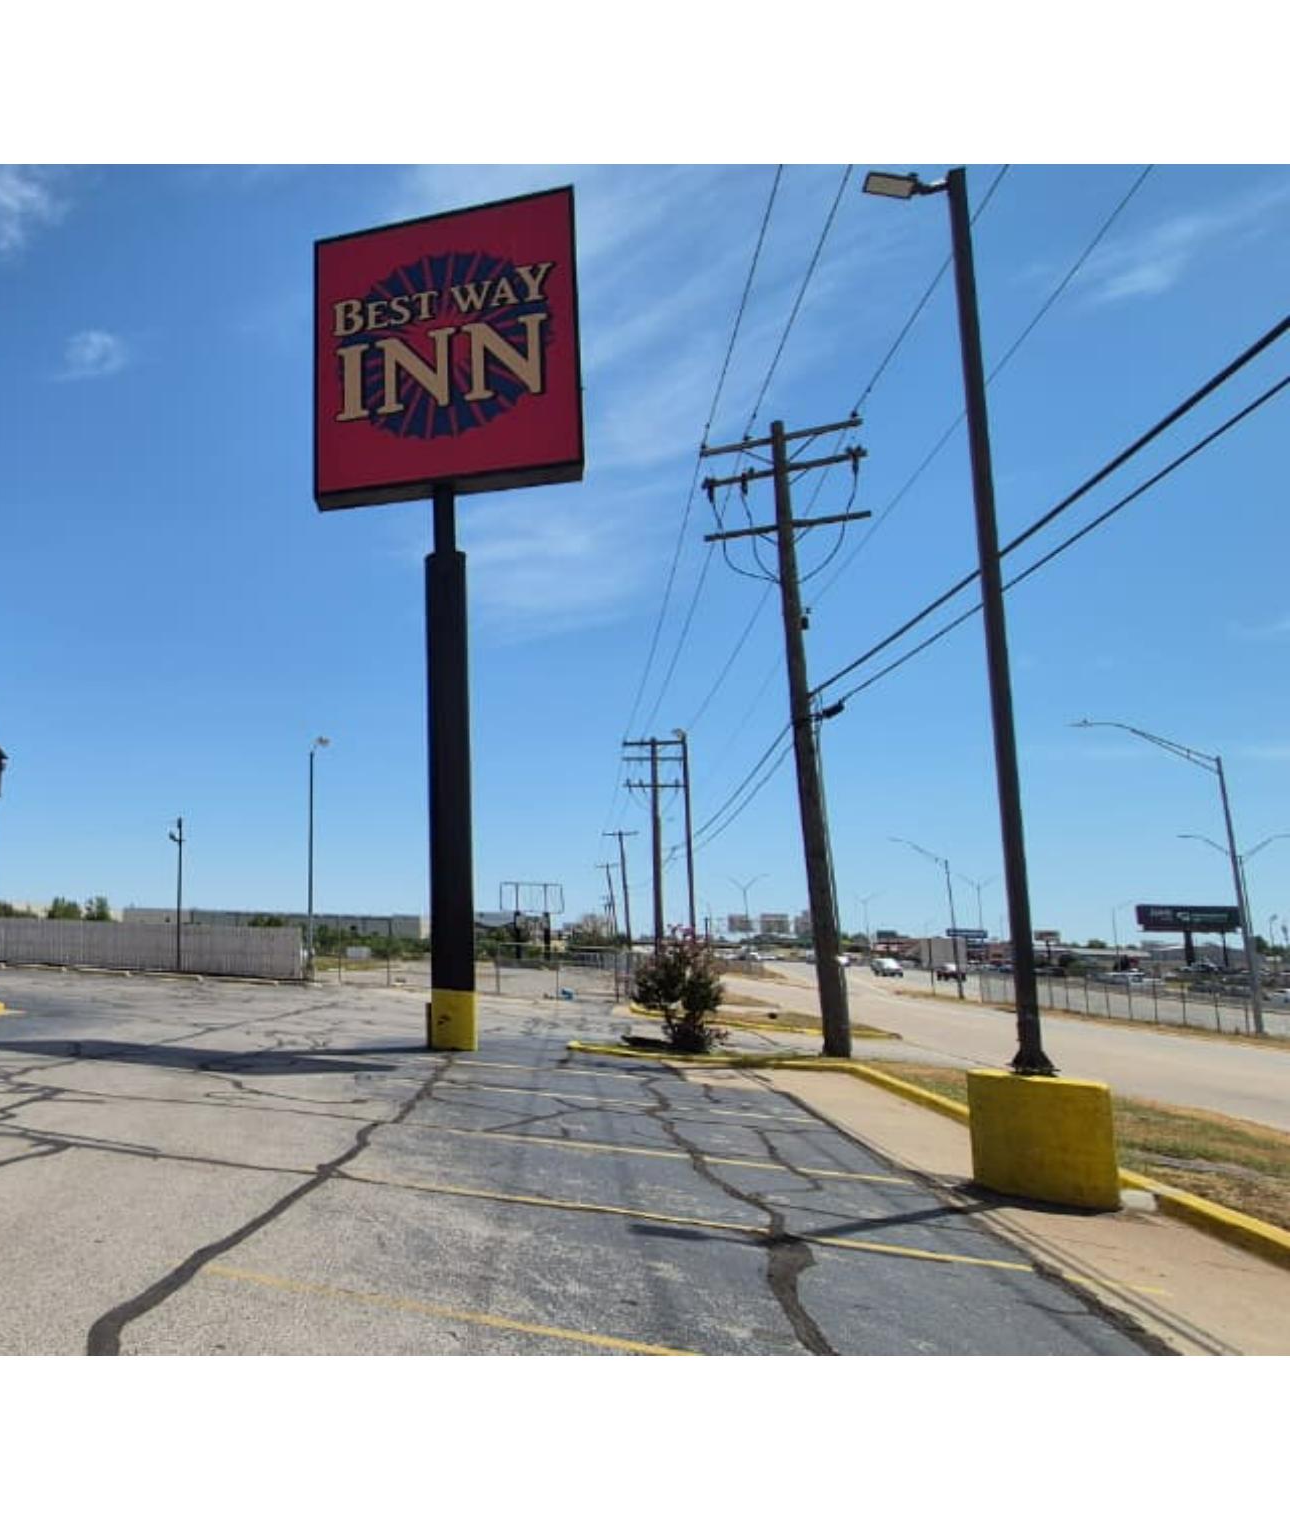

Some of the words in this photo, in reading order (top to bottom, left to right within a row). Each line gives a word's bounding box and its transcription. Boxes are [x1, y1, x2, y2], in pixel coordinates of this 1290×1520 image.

[334, 292, 437, 335] BEST
[452, 263, 551, 312] WAY
[337, 315, 546, 421] INN
